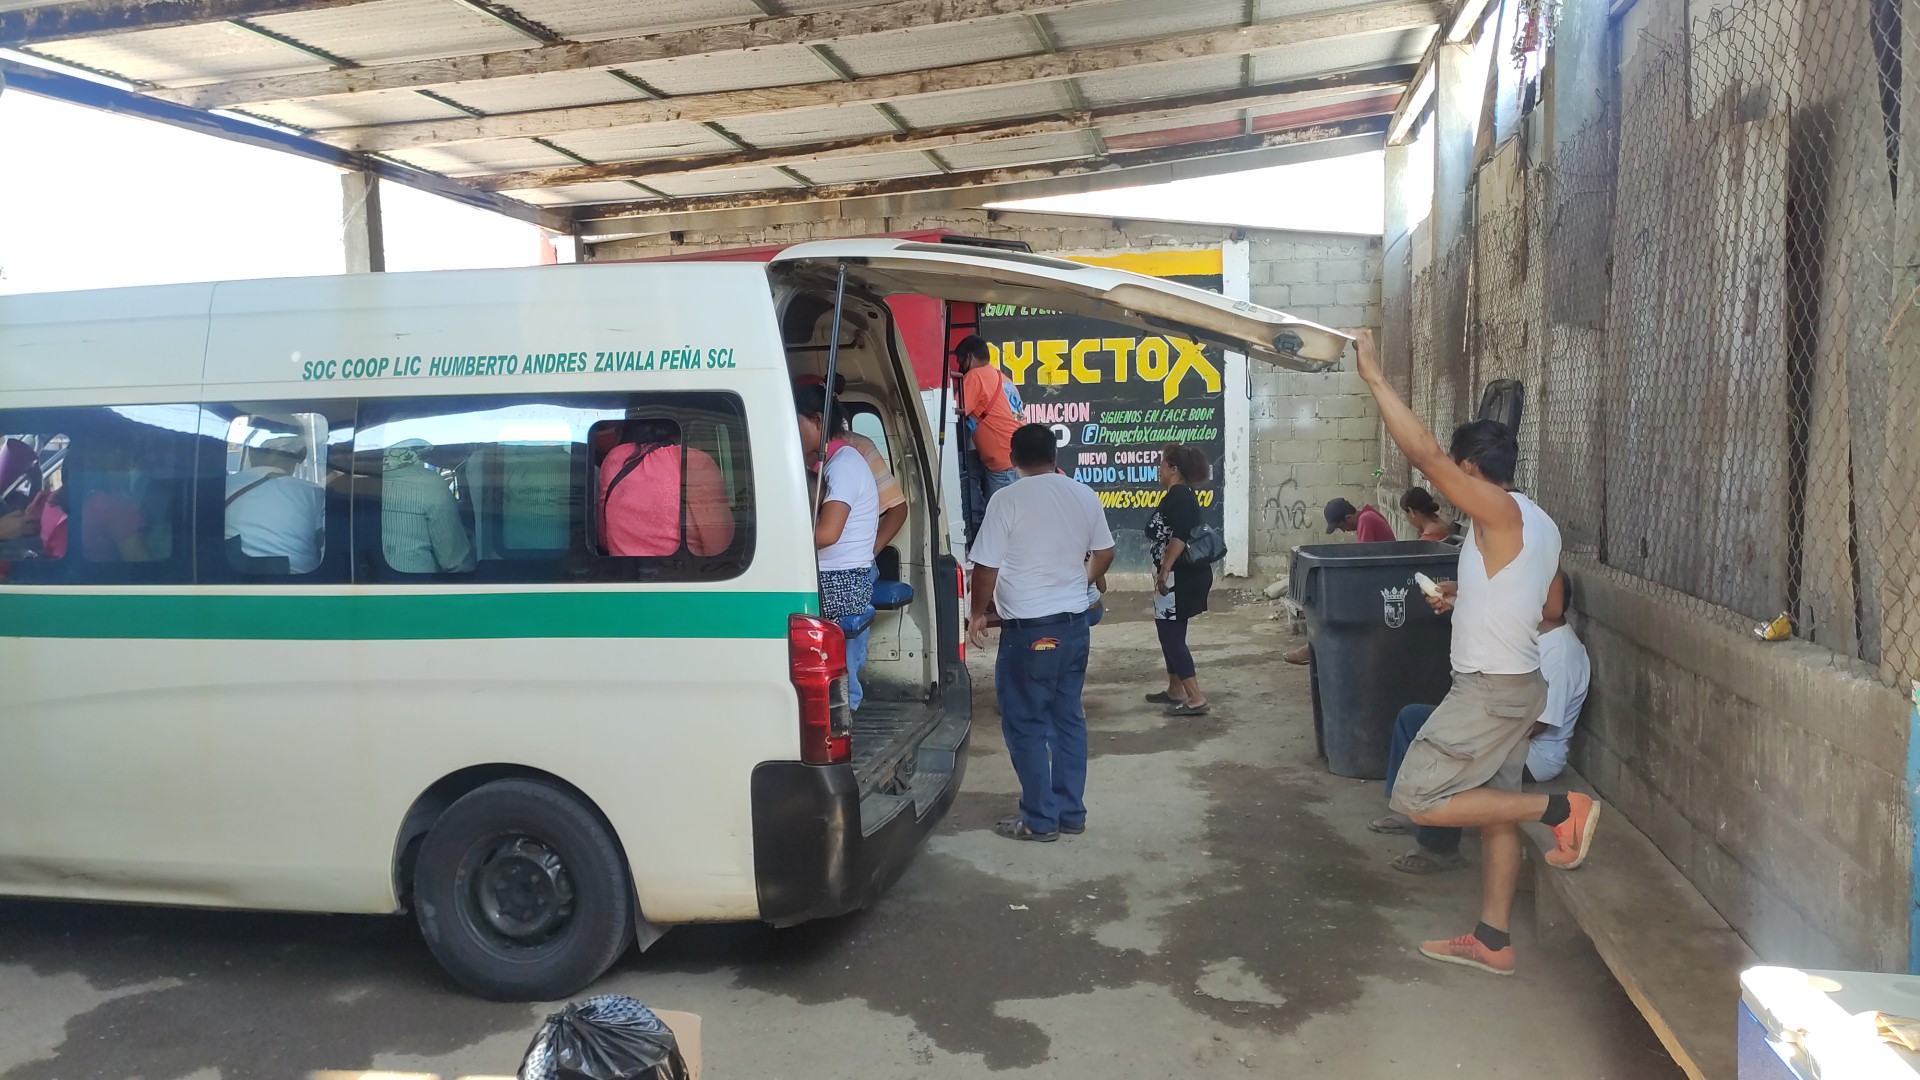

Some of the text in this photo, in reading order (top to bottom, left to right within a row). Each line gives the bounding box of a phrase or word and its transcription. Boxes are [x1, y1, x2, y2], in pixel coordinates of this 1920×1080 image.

[302, 344, 737, 381] SOC COOP LIC HUMBERTO ANDRES ZAVALA PEÑA SCL
[1100, 407, 1216, 424] SIGUENOS EN FACE BOOK
[1098, 423, 1218, 448] ProyectoXaudioyvideo
[1078, 450, 1164, 465] NUEVO CONCEPT
[1073, 466, 1117, 483] AUDIO
[1127, 465, 1160, 483] ILUM
